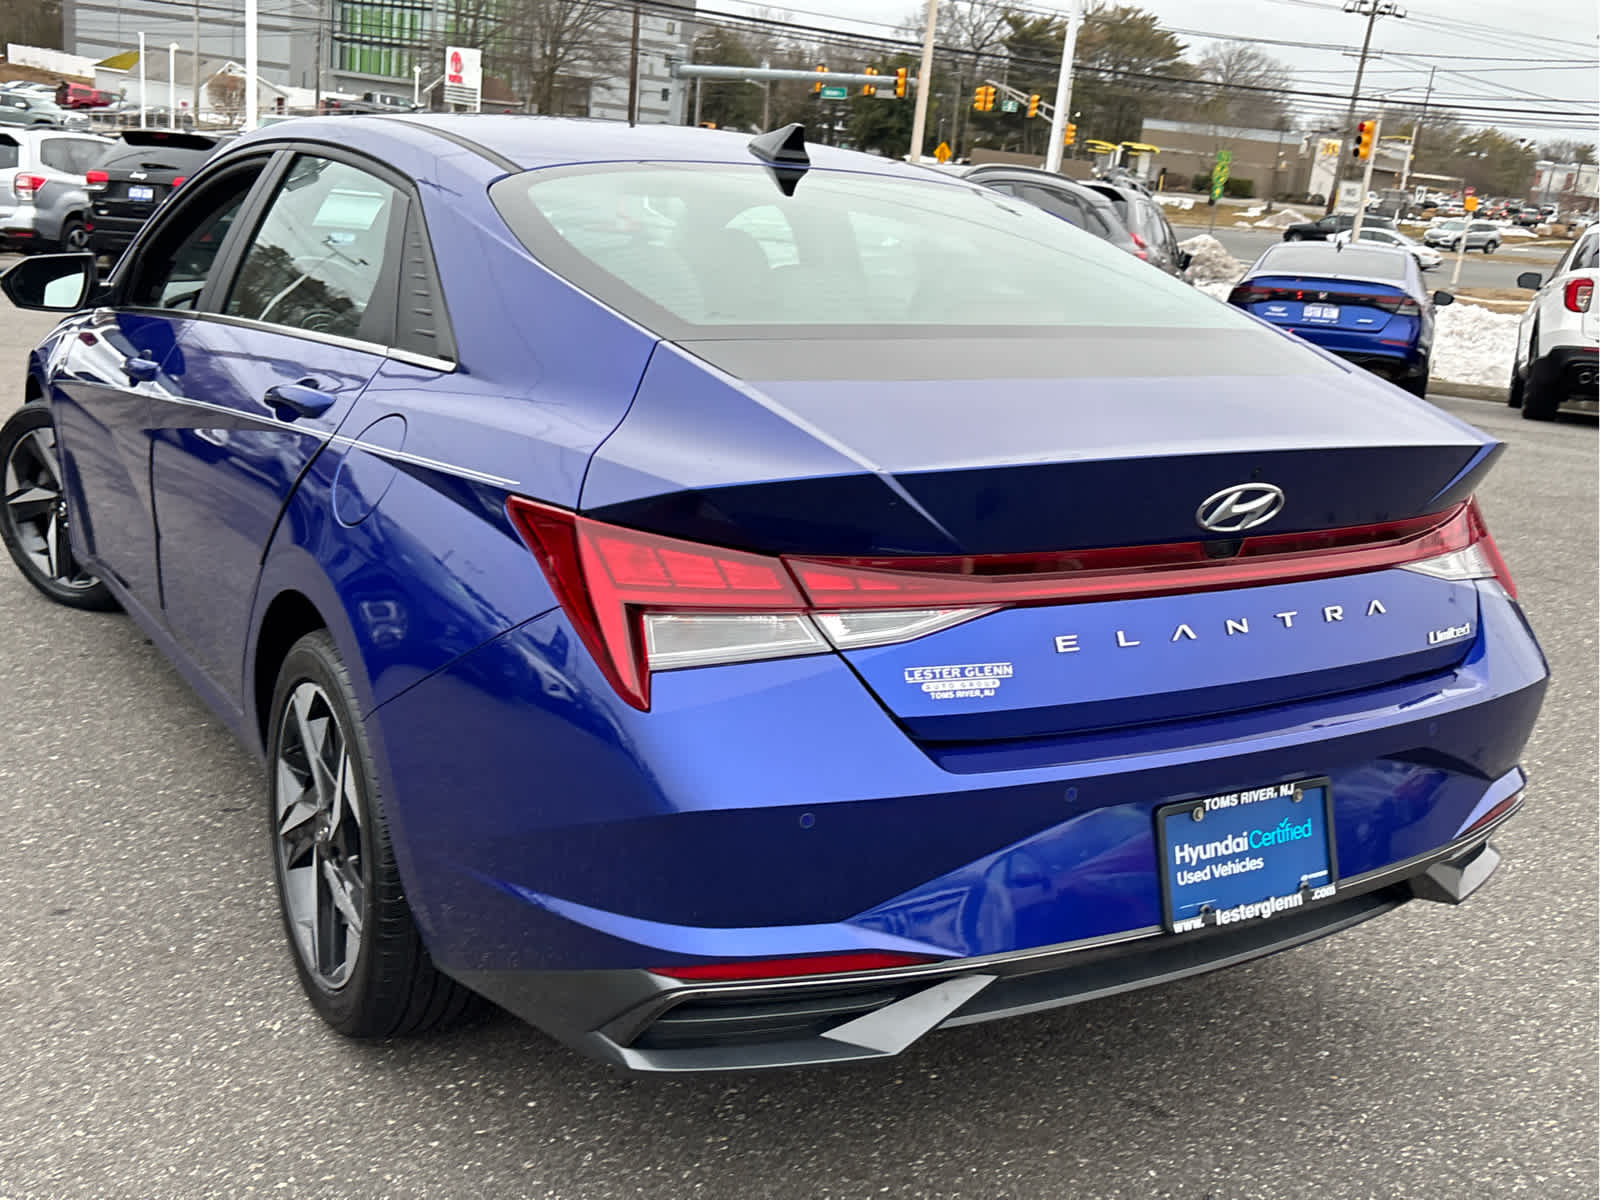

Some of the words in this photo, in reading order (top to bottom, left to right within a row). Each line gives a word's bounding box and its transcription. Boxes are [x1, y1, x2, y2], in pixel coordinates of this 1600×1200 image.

[1055, 599, 1386, 652] ELANTRA
[1429, 622, 1471, 645] Limited
[904, 667, 960, 680] LESTER
[964, 664, 1012, 677] GLENN
[930, 690, 954, 699] TOMS
[1203, 793, 1239, 812] TOMS
[1240, 786, 1278, 805] RIVER,
[1280, 784, 1295, 796] NJ
[1174, 831, 1249, 866] Hyundai
[1248, 818, 1312, 849] Certified
[1177, 864, 1211, 886] Used
[1211, 857, 1265, 878] Vehicles
[1216, 893, 1303, 925] lesterglenn
